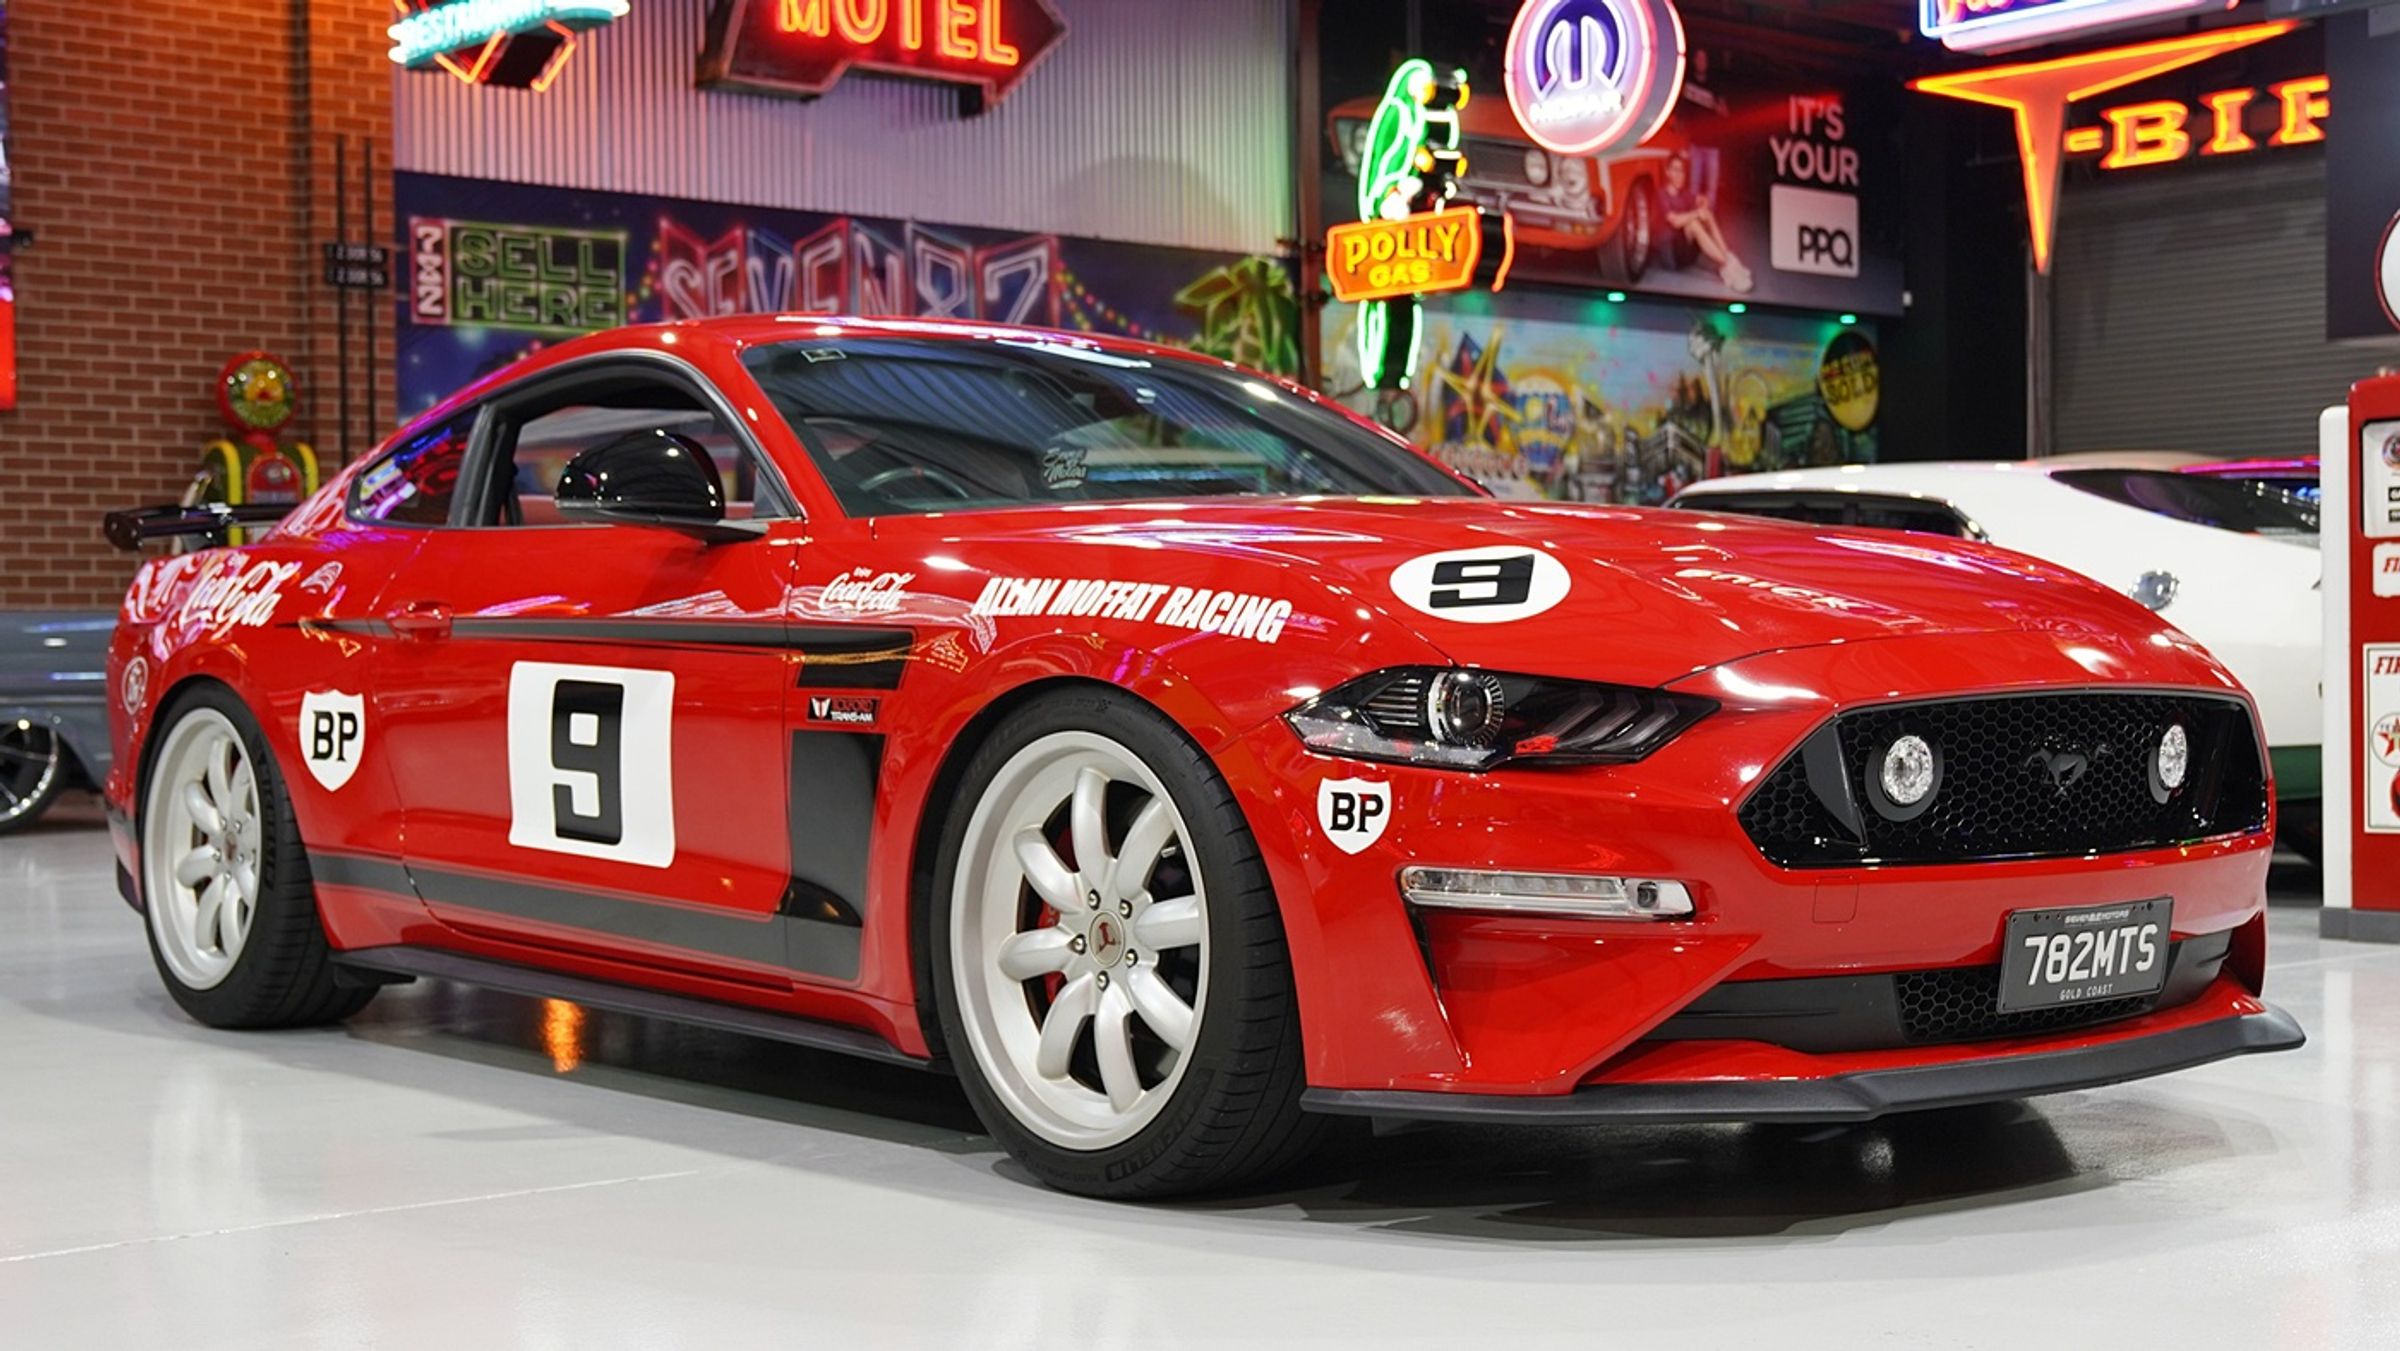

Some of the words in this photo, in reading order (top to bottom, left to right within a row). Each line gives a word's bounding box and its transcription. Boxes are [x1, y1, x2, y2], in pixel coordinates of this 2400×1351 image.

[778, 0, 1019, 66] MOTEL
[1789, 95, 1845, 141] IT'S
[1769, 136, 1859, 186] YOUR
[456, 230, 618, 285] SELL
[1343, 223, 1460, 273] POLLY
[1798, 224, 1853, 268] PPQ
[1368, 259, 1431, 288] GAS
[456, 276, 618, 327] HERE
[1429, 553, 1536, 609] 9
[971, 577, 1061, 617] ALLAN
[1047, 578, 1170, 622] MOFFAT
[1154, 586, 1293, 644] RACING
[312, 710, 358, 762] BP
[551, 679, 625, 846] 9
[1329, 791, 1385, 833] BP
[2024, 923, 2158, 986] 782MTS
[2060, 988, 2081, 1001] GOLD
[2086, 984, 2114, 999] COAST
